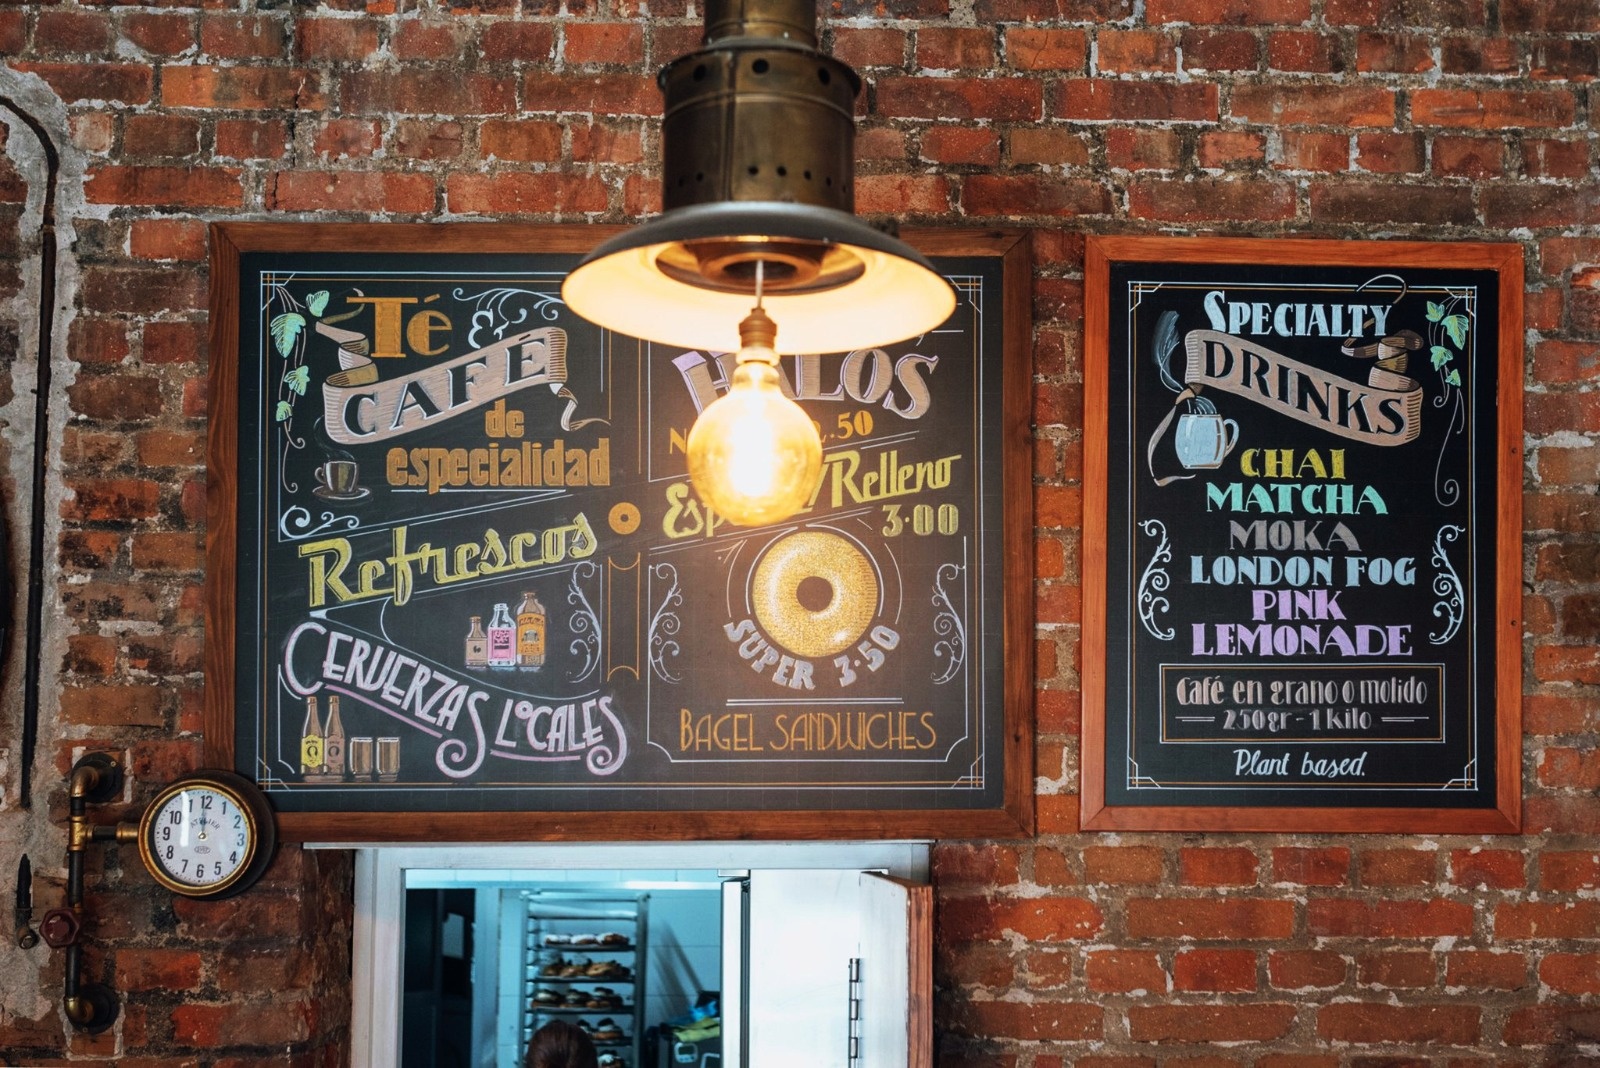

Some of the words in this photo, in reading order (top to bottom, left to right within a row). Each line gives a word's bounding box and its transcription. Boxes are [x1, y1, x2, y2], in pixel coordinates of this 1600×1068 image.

[346, 293, 452, 358] Té
[1203, 290, 1392, 338] SPECIALTY
[1201, 340, 1406, 436] DRINKS
[485, 399, 524, 438] de
[386, 438, 611, 495] especialidad
[1240, 448, 1346, 480] CHAI
[1206, 482, 1389, 515] MATCHA
[1229, 520, 1362, 551] MOKA
[298, 511, 598, 607] Refrescos
[1190, 555, 1333, 587] LONDON
[1345, 556, 1416, 587] FOG
[1251, 589, 1347, 621] PINK
[722, 619, 815, 690] SUPER
[1191, 623, 1413, 656] LEMONADE
[1176, 675, 1225, 705] Café
[1232, 680, 1263, 705] en
[1270, 679, 1338, 705] grano
[1360, 676, 1428, 705] molido
[680, 708, 764, 751] BAGEL
[769, 711, 937, 751] SANDWICHES
[1327, 707, 1372, 730] kilo
[494, 696, 628, 776] LOCALES
[1233, 749, 1291, 776] Plant
[1300, 751, 1368, 778] based.
[169, 810, 182, 825] 10
[200, 795, 213, 810] 12
[222, 801, 227, 815] 1
[162, 826, 170, 841] 9
[233, 815, 241, 829] 2
[166, 845, 174, 859] 8
[237, 833, 245, 847] 3
[181, 859, 188, 873] 7
[196, 864, 205, 878] 6
[214, 862, 222, 876] 5
[229, 851, 237, 864] 4
